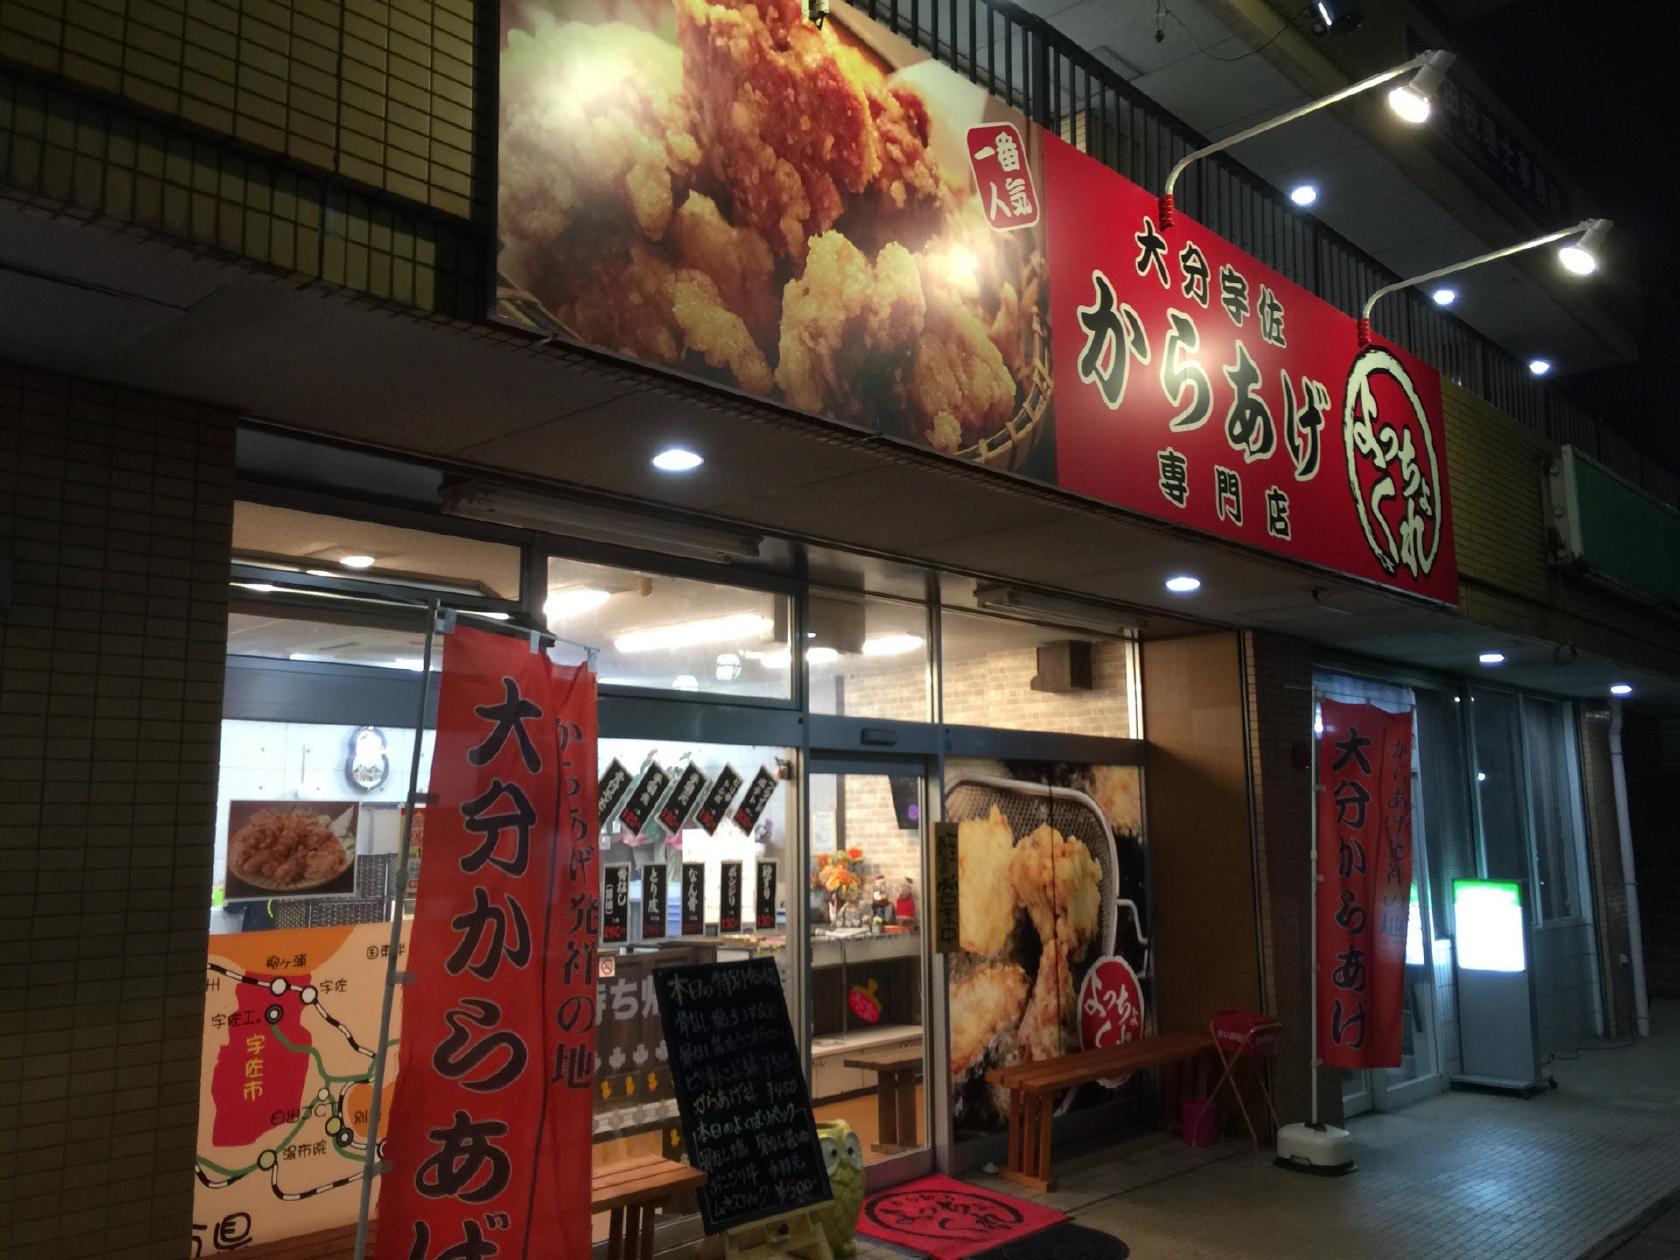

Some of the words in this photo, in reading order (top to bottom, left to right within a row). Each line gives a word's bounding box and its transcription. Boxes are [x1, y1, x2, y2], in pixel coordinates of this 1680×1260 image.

[974, 131, 1021, 172] 一番
[1134, 216, 1287, 348] 大分宇佐
[1078, 270, 1331, 482] からあげ
[1157, 447, 1292, 541] 専門店
[319, 978, 348, 993] 宇佐
[243, 1034, 265, 1101] 宇佐市
